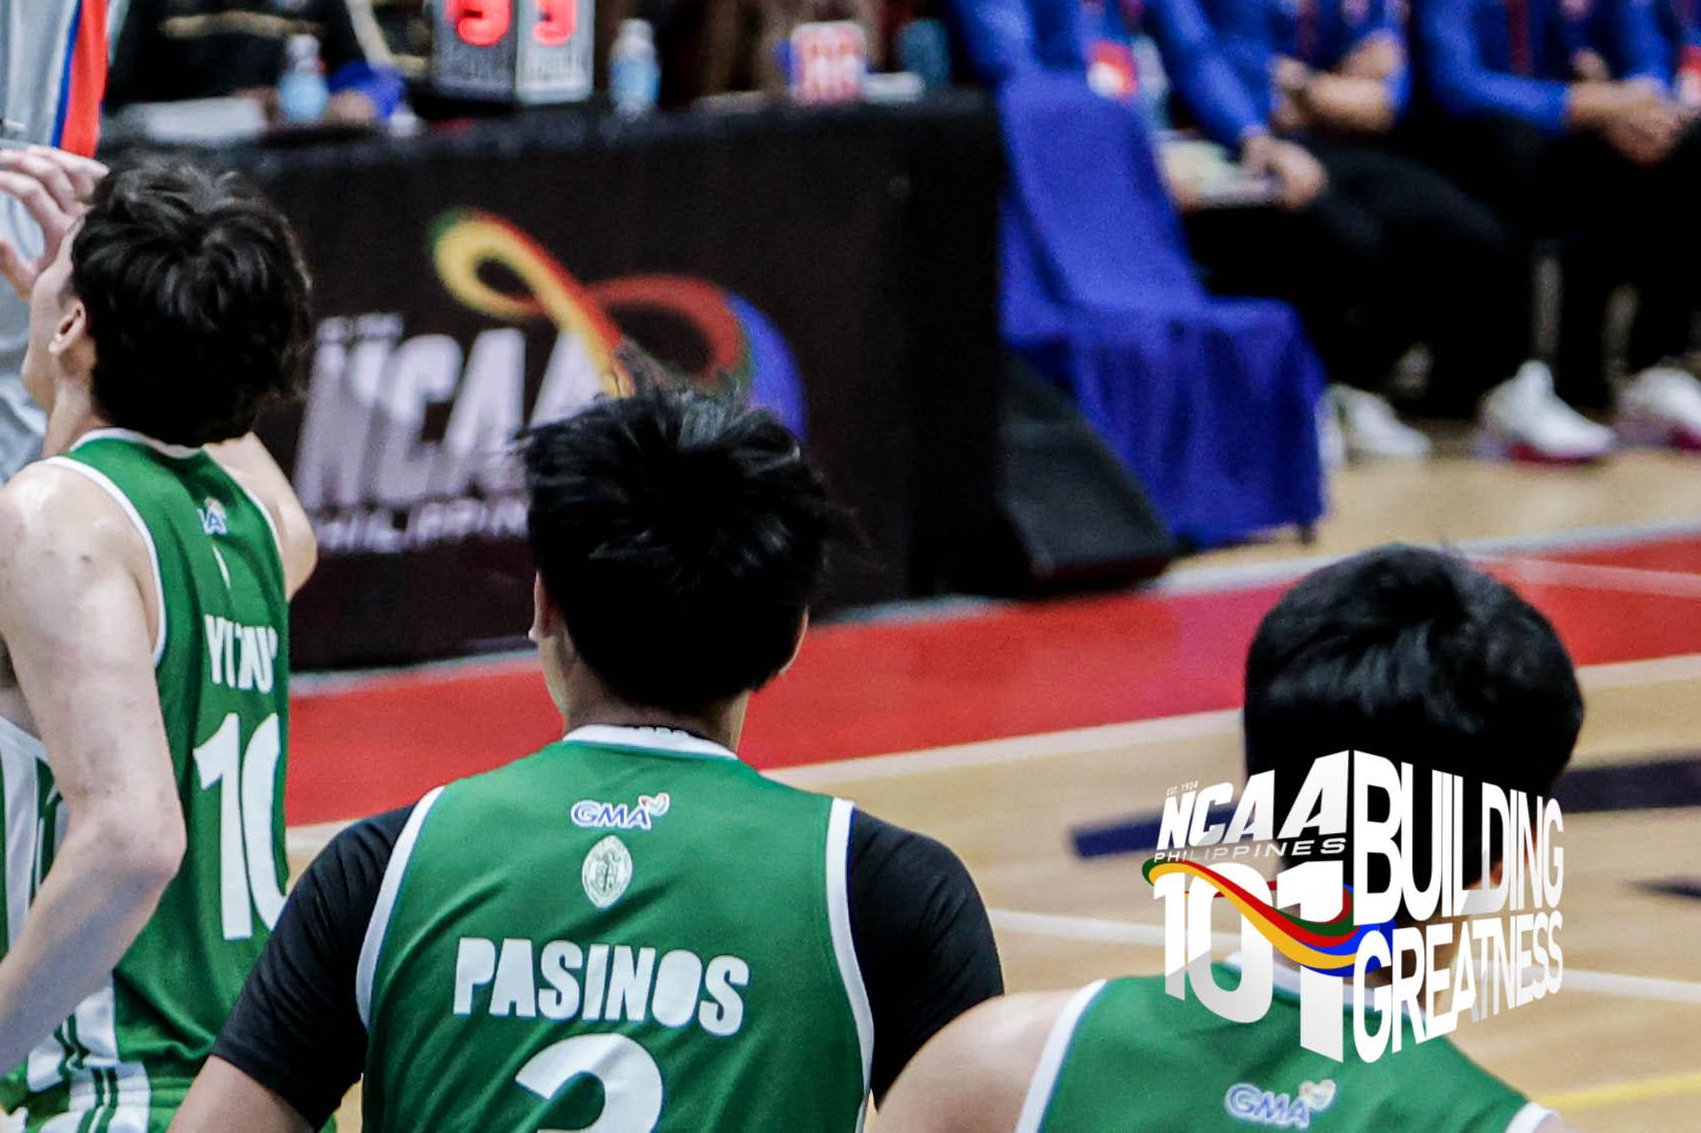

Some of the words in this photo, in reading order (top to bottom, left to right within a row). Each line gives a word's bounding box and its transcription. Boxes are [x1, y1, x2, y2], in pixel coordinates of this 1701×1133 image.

[571, 798, 653, 830] GMA
[453, 936, 750, 1037] PASINOS
[1225, 1083, 1310, 1130] GMA
